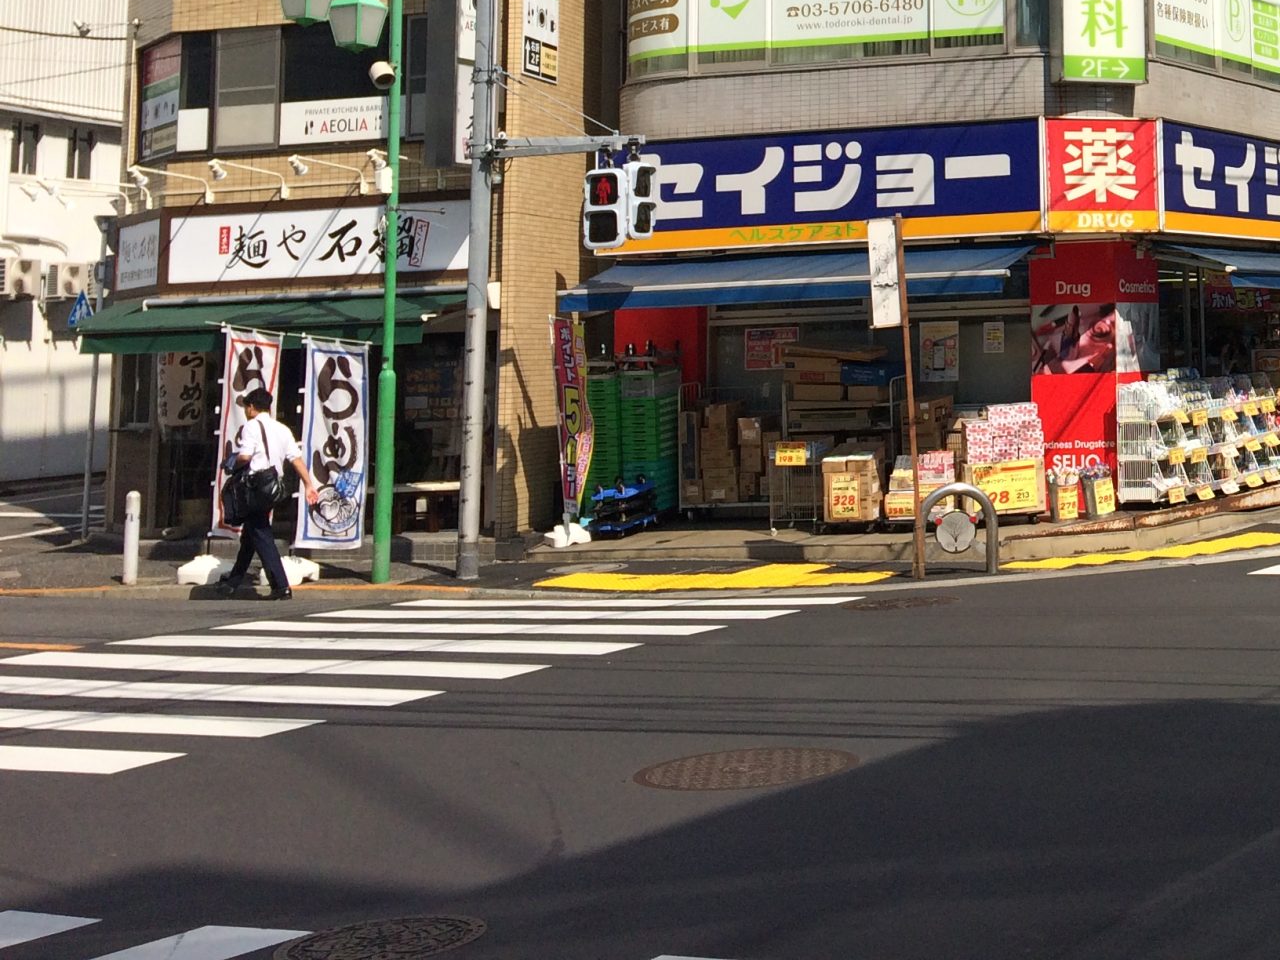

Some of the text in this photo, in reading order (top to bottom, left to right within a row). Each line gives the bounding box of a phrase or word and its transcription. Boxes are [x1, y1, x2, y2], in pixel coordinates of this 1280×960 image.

[796, 15, 913, 31] www.todoroki-dental.jp
[530, 53, 540, 65] 2F
[1081, 58, 1107, 77] 2F
[331, 106, 358, 114] KITCHEN
[320, 118, 368, 134] AEOLIA
[1063, 127, 1139, 204] 薬
[648, 141, 1010, 219] セイジョー
[1077, 211, 1134, 229] DRUG
[1055, 280, 1091, 298] Drug
[1118, 278, 1156, 295] Cosmetics
[1075, 439, 1115, 450] Drugstore
[833, 495, 855, 507] 328
